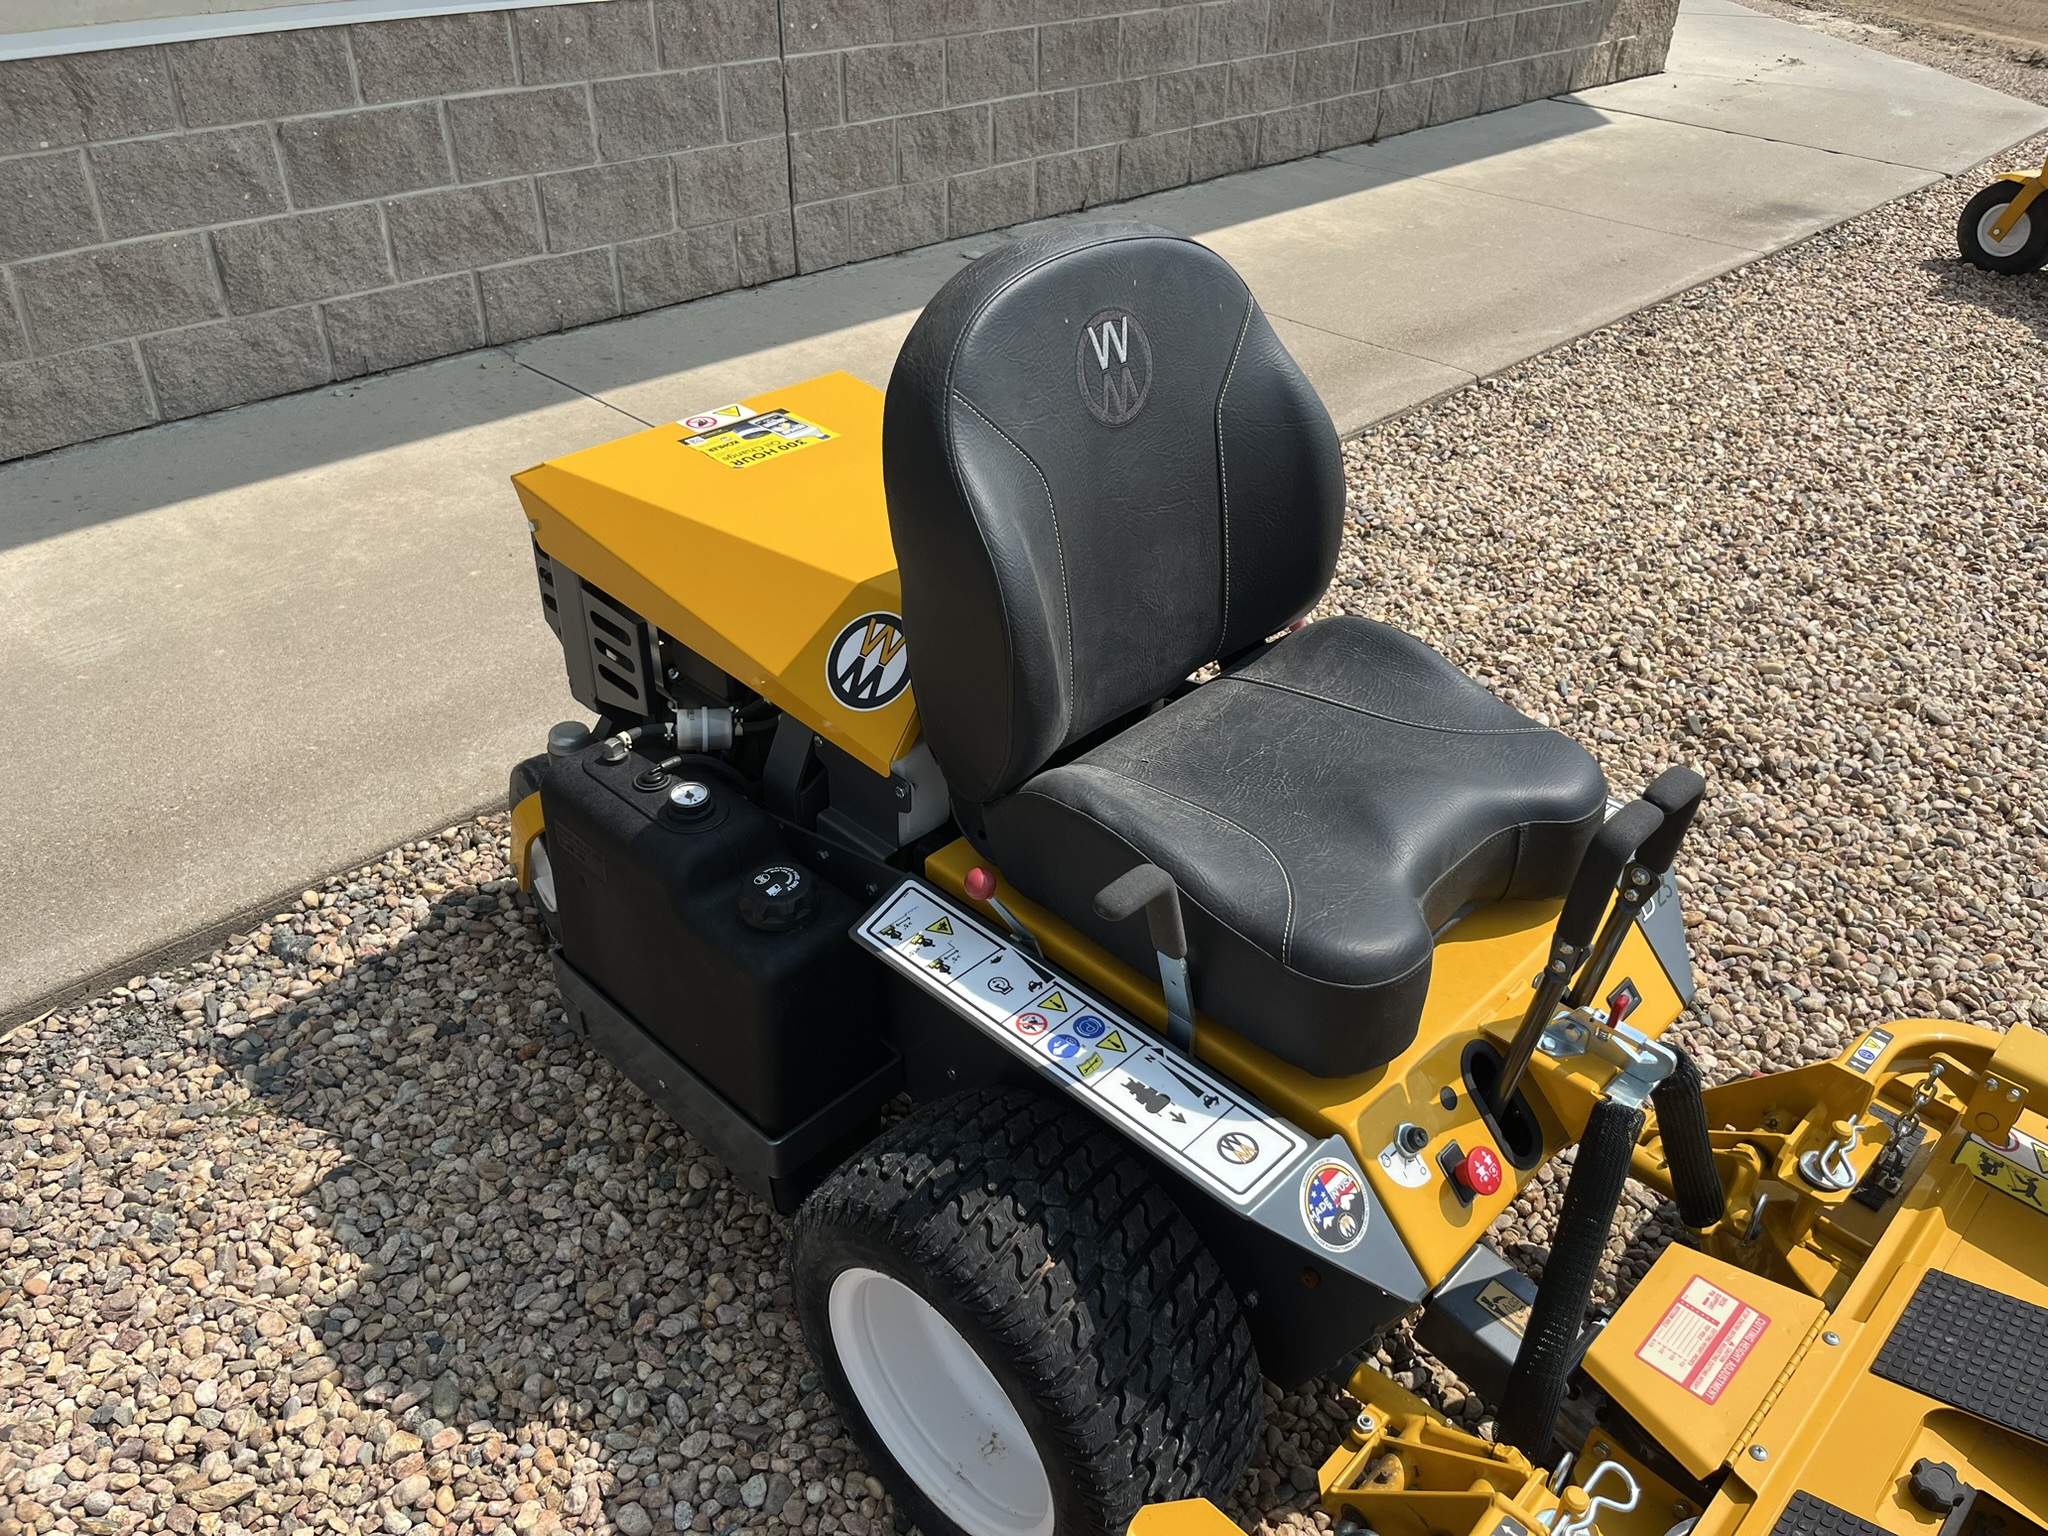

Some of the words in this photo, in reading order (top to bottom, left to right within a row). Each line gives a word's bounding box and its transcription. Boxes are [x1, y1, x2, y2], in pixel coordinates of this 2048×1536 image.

[1087, 315, 1128, 370] W
[1101, 366, 1139, 415] M
[722, 446, 764, 461] Change
[731, 448, 779, 466] HOUR
[777, 439, 807, 451] 300
[860, 617, 906, 667] W
[838, 655, 885, 700] M
[1330, 1187, 1341, 1202] IN
[1339, 1175, 1354, 1191] USA
[1309, 1197, 1331, 1221] MADE
[1744, 1316, 1766, 1343] CUTTING
[1730, 1339, 1750, 1363] HEIGHT
[1704, 1359, 1736, 1400] ADJUSTMENT
